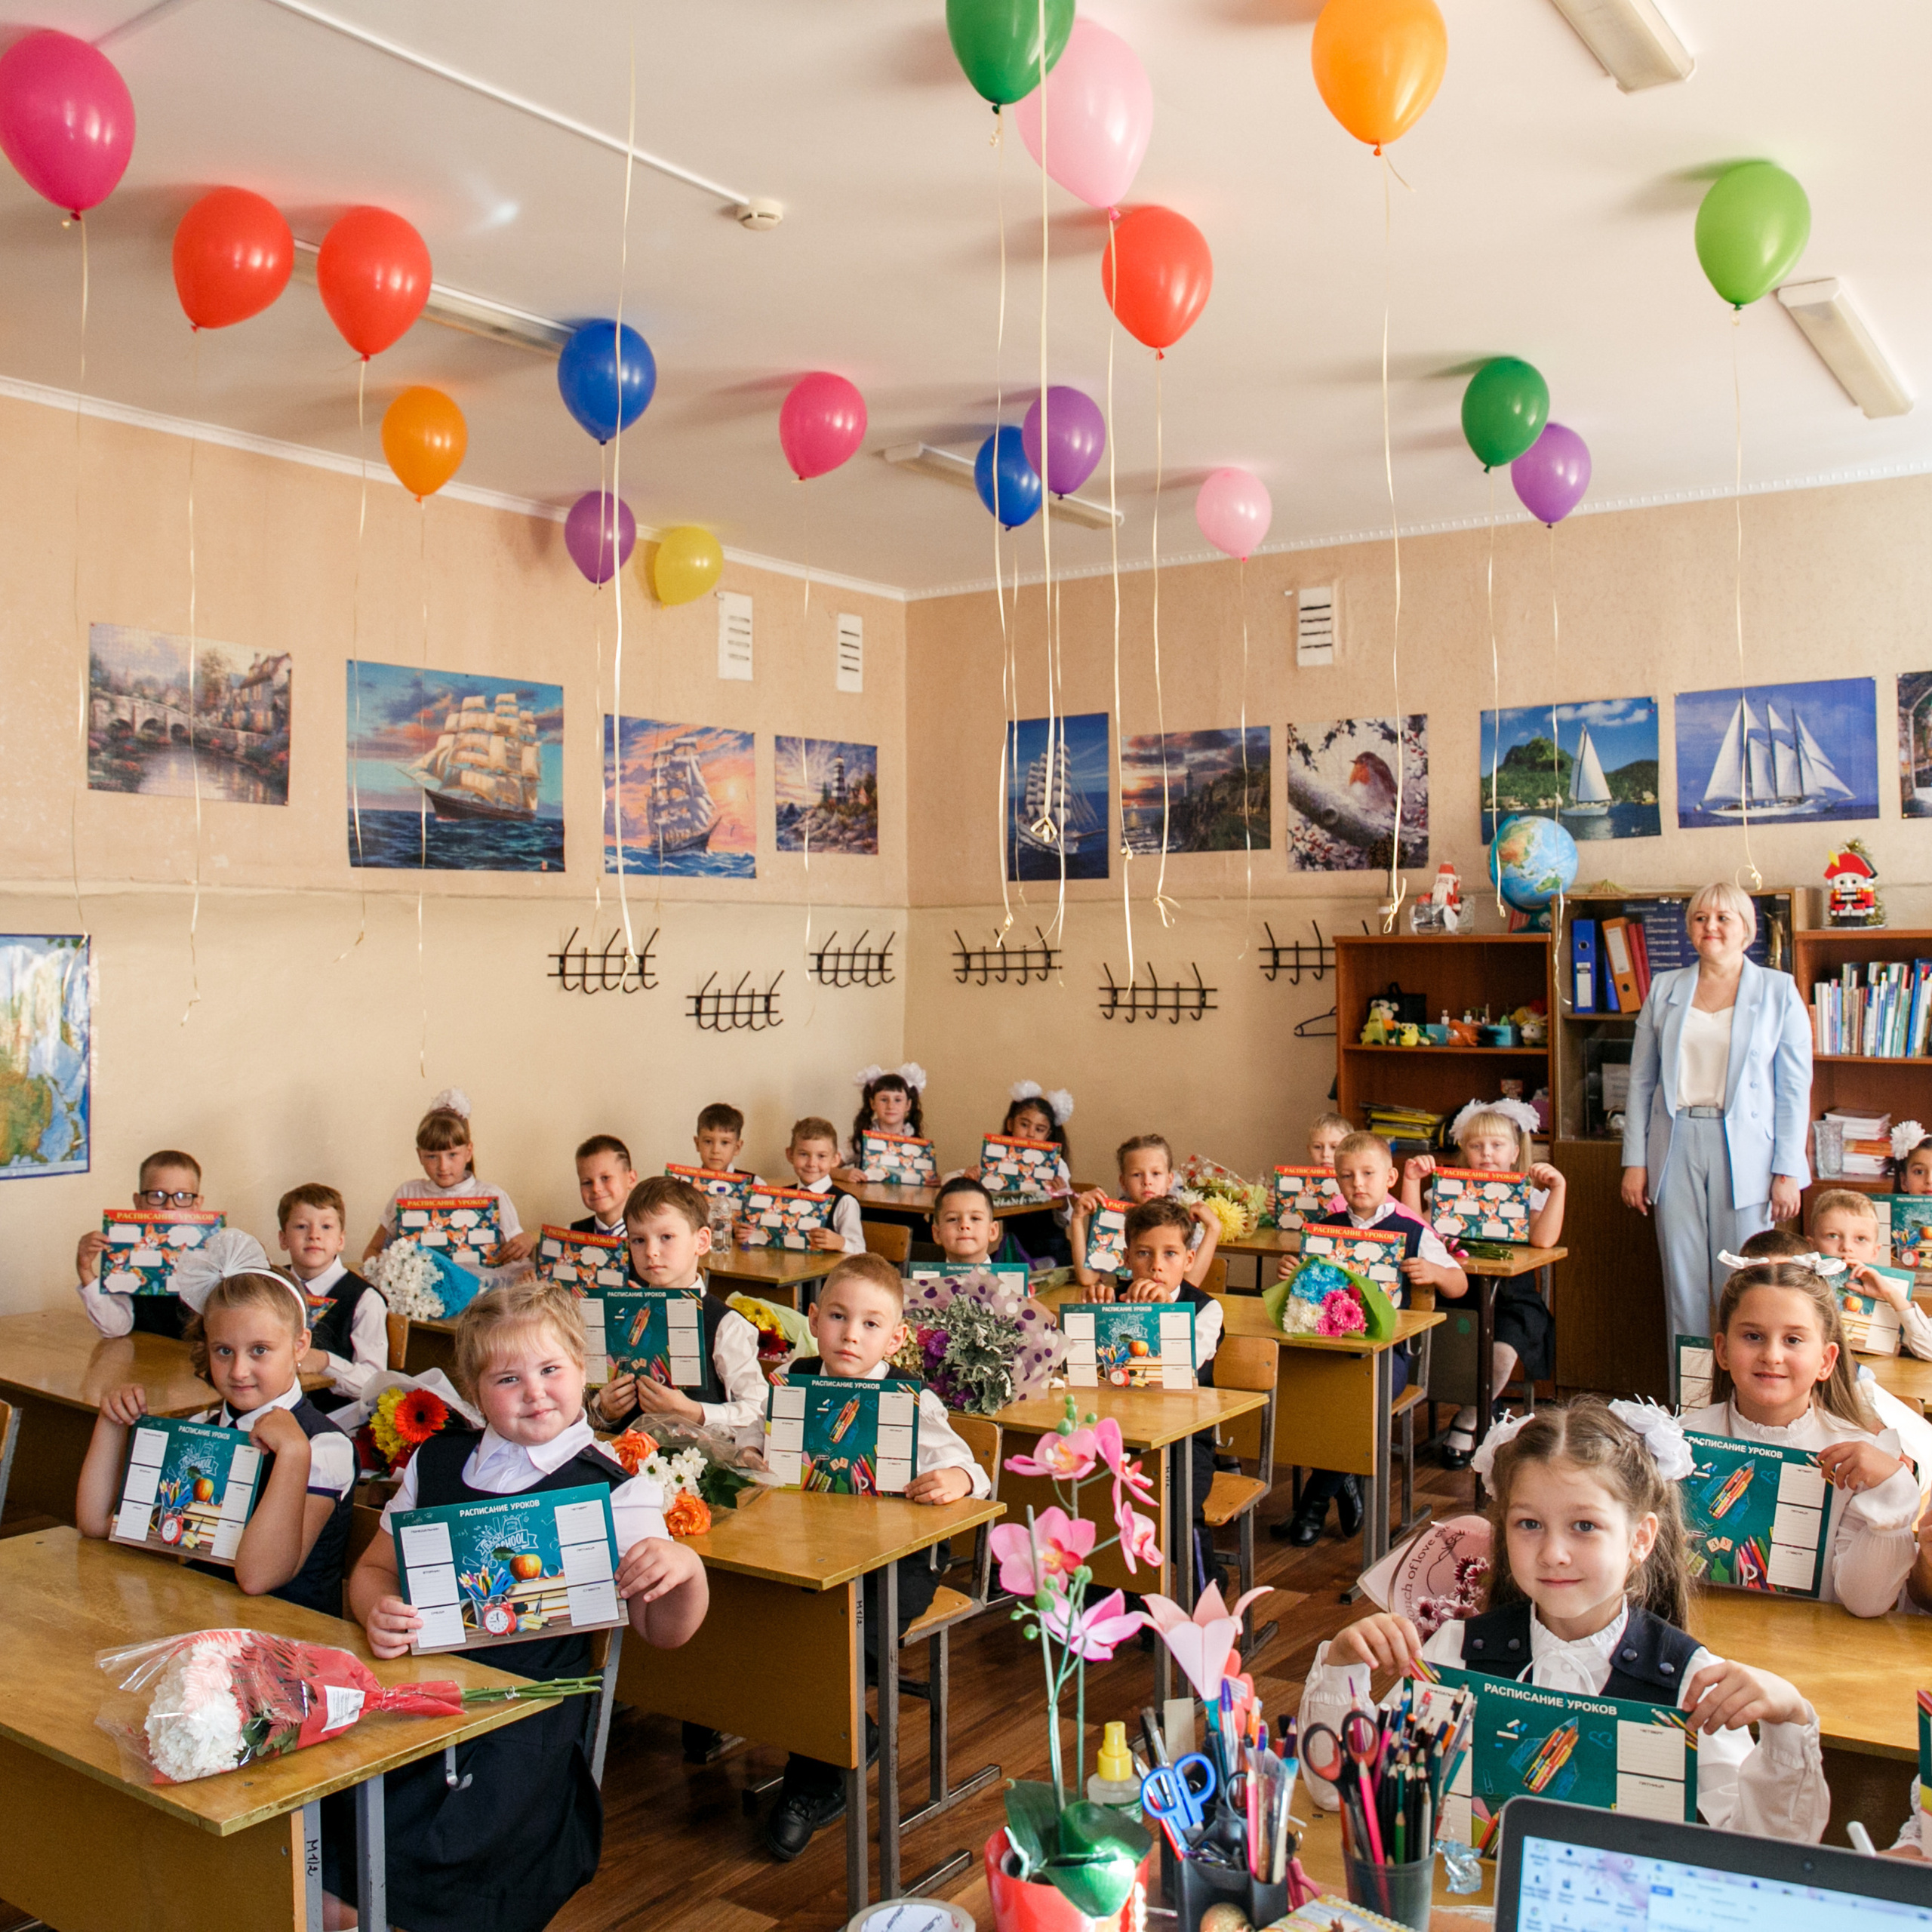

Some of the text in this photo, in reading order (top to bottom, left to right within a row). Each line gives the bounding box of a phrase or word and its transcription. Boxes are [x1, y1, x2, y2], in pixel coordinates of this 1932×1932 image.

[1444, 1170, 1489, 1178] РАСПИСАНИЕ
[1313, 1226, 1395, 1239] РАСПИСАНИЕ УРОКОВ
[812, 1380, 853, 1388] РАСПИСАНИЕ
[178, 1425, 230, 1440] РАСПИСАНИЕ УРОКОВ
[1688, 1436, 1783, 1459] РАСПИСАНИЕ УРОКОВ
[459, 1500, 540, 1517] РАСПИСАНИЕ УРОКОВ
[1414, 1539, 1435, 1564] love
[1408, 1563, 1418, 1580] of
[1401, 1583, 1416, 1621] ouch
[1484, 1683, 1618, 1716] РАСПИСАНИЕ УРОКОВ
